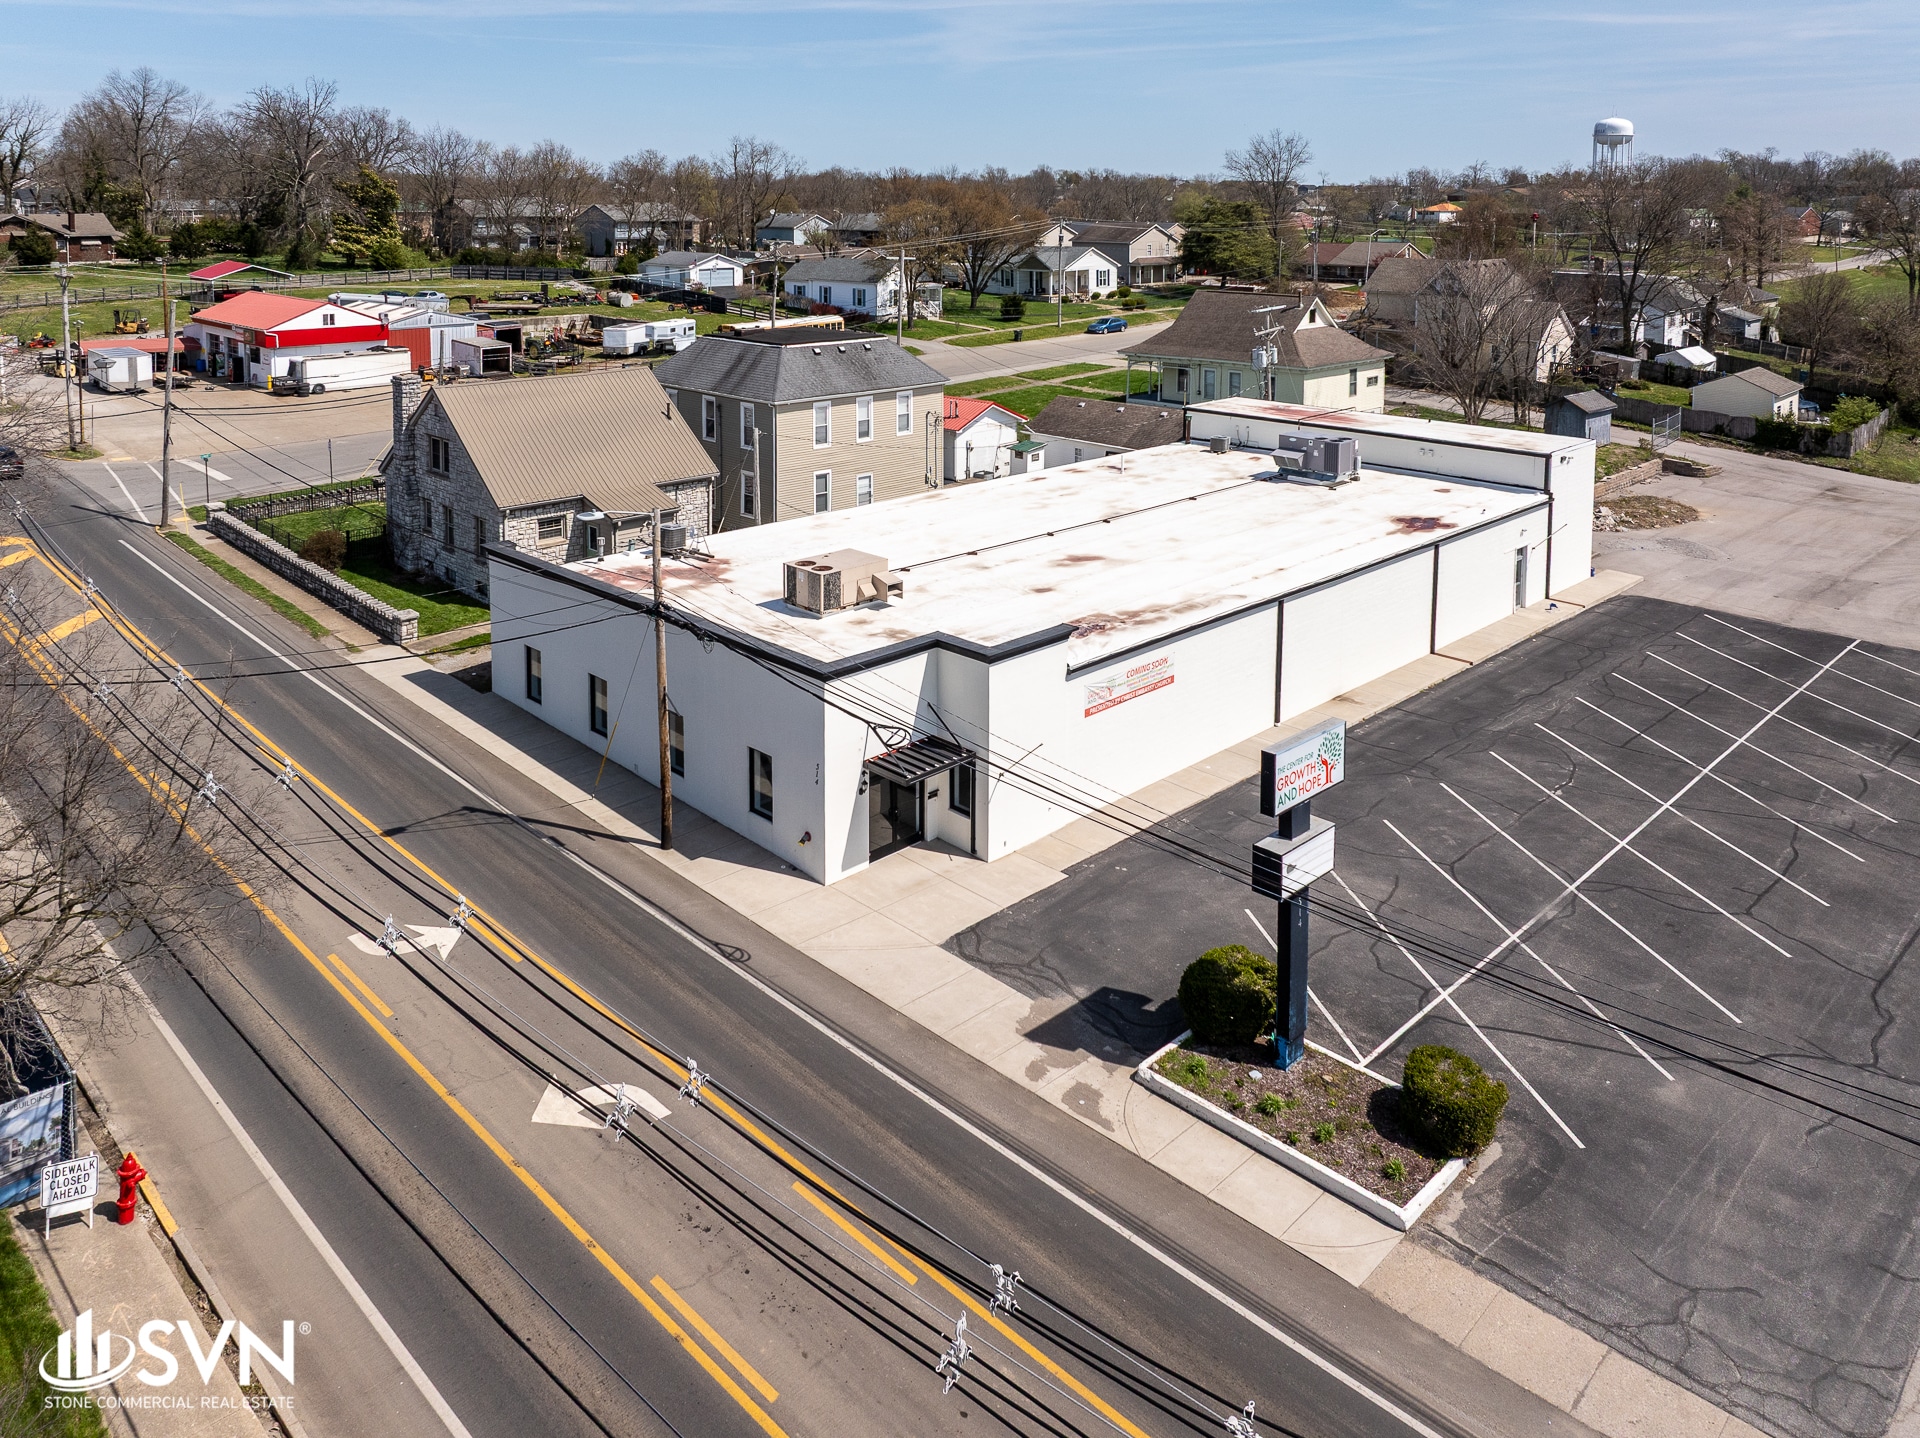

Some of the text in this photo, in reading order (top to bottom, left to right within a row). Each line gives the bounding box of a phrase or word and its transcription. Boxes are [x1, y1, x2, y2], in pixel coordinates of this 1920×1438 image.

[1126, 663, 1151, 678] COMING
[1151, 656, 1168, 670] SOON
[1277, 752, 1314, 776] THE CENTER FOR
[1277, 761, 1316, 792] GROWTH
[1277, 774, 1322, 808] AND HOPE
[14, 1092, 53, 1110] BUILDING
[44, 1160, 96, 1180] SIDEWALK
[50, 1173, 90, 1191] CLOSED
[52, 1185, 87, 1201] AHEAD
